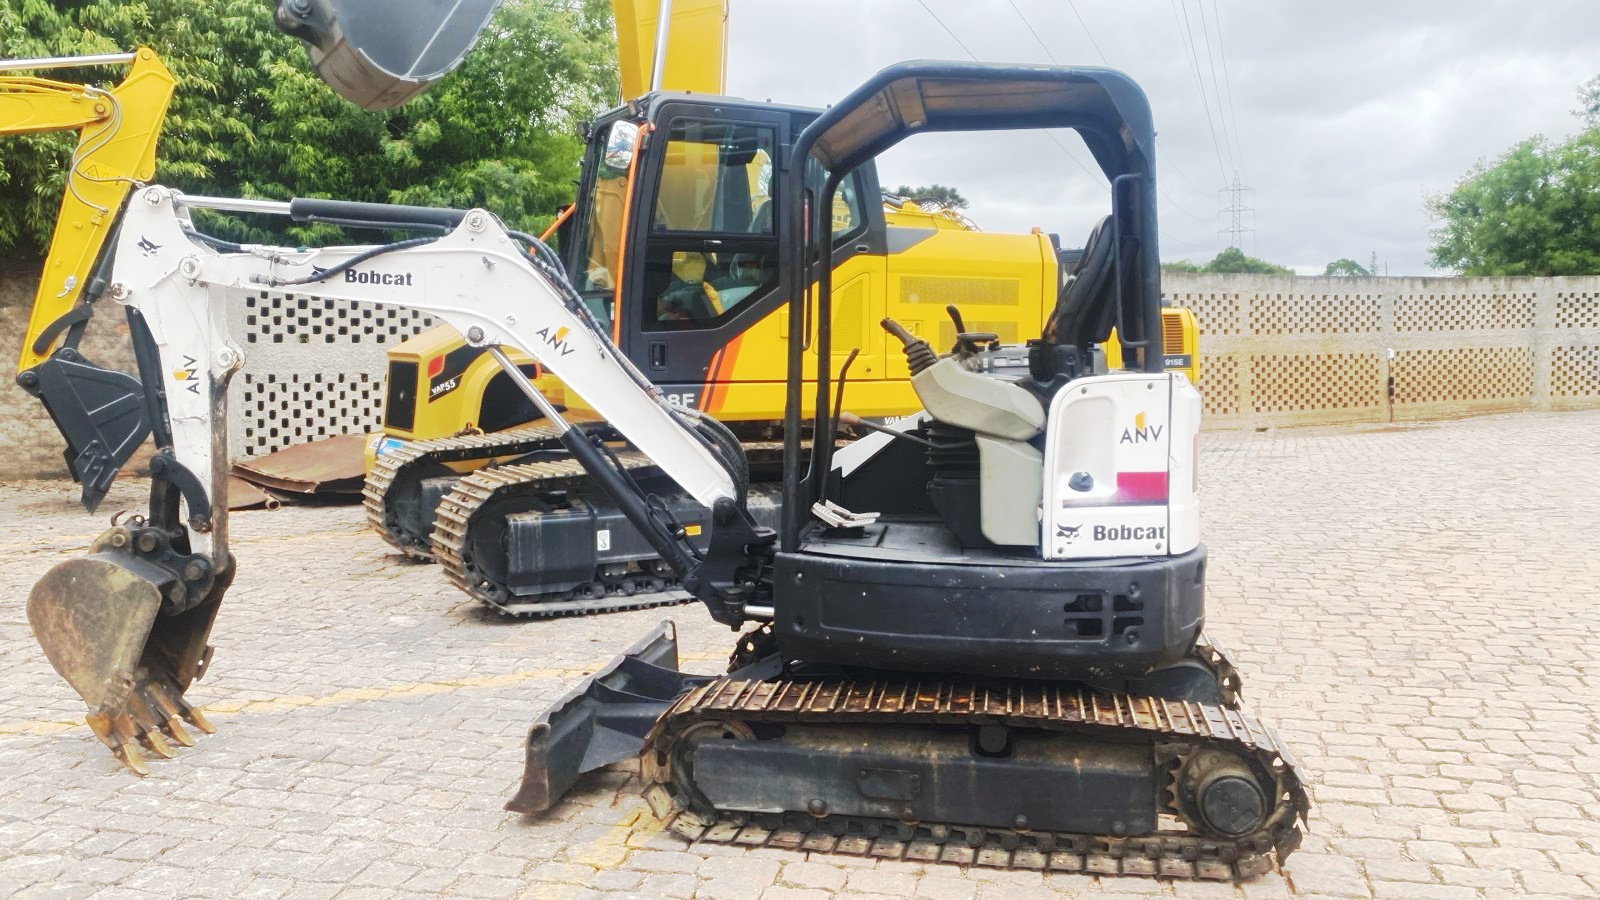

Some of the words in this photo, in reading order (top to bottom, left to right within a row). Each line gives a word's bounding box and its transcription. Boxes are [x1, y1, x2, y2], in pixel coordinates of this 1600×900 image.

[345, 268, 412, 286] Bobcat
[535, 326, 575, 357] ANV
[1164, 358, 1184, 366] 915E
[183, 354, 200, 395] ANV
[431, 379, 456, 394] VAP55
[667, 393, 695, 408] 8F
[1119, 424, 1163, 444] ANV
[1093, 524, 1166, 541] Bobcat
